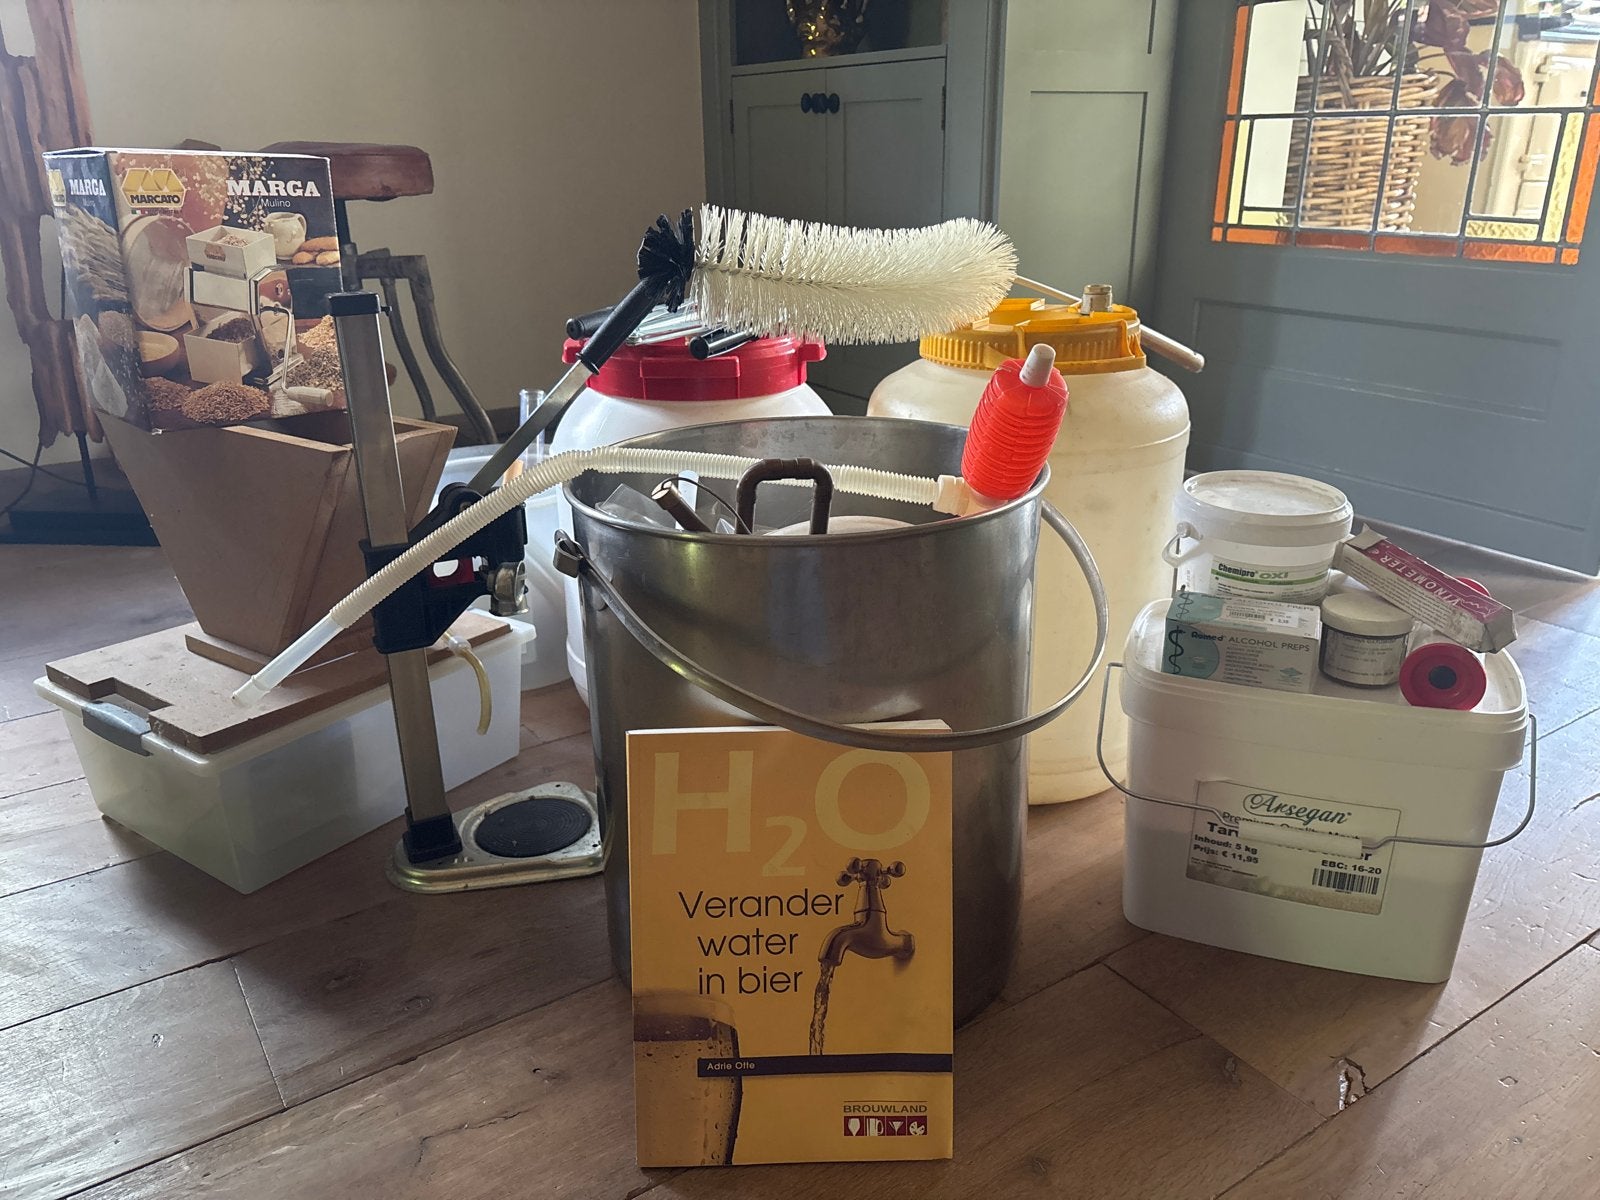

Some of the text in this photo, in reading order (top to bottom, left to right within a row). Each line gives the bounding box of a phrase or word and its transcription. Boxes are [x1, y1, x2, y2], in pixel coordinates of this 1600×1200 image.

[68, 177, 106, 197] MARGA
[226, 179, 321, 197] MARGA
[130, 194, 181, 204] MARCATO
[261, 199, 291, 208] Mulino
[1380, 555, 1460, 607] VINOMETER
[1191, 631, 1311, 652] Romed ALCOHOL PREPS
[1193, 844, 1218, 857] Prijs:
[1222, 850, 1228, 858] €
[1231, 852, 1259, 864] 11,95
[1194, 833, 1258, 855] Inhoud: 5 kg
[1321, 859, 1382, 875] EBC: 16-20
[678, 888, 844, 919] Verander
[697, 928, 798, 957] water
[698, 966, 803, 995] in bier
[707, 1061, 756, 1071] Adrie Otte
[843, 1103, 928, 1114] BROUWLAND
